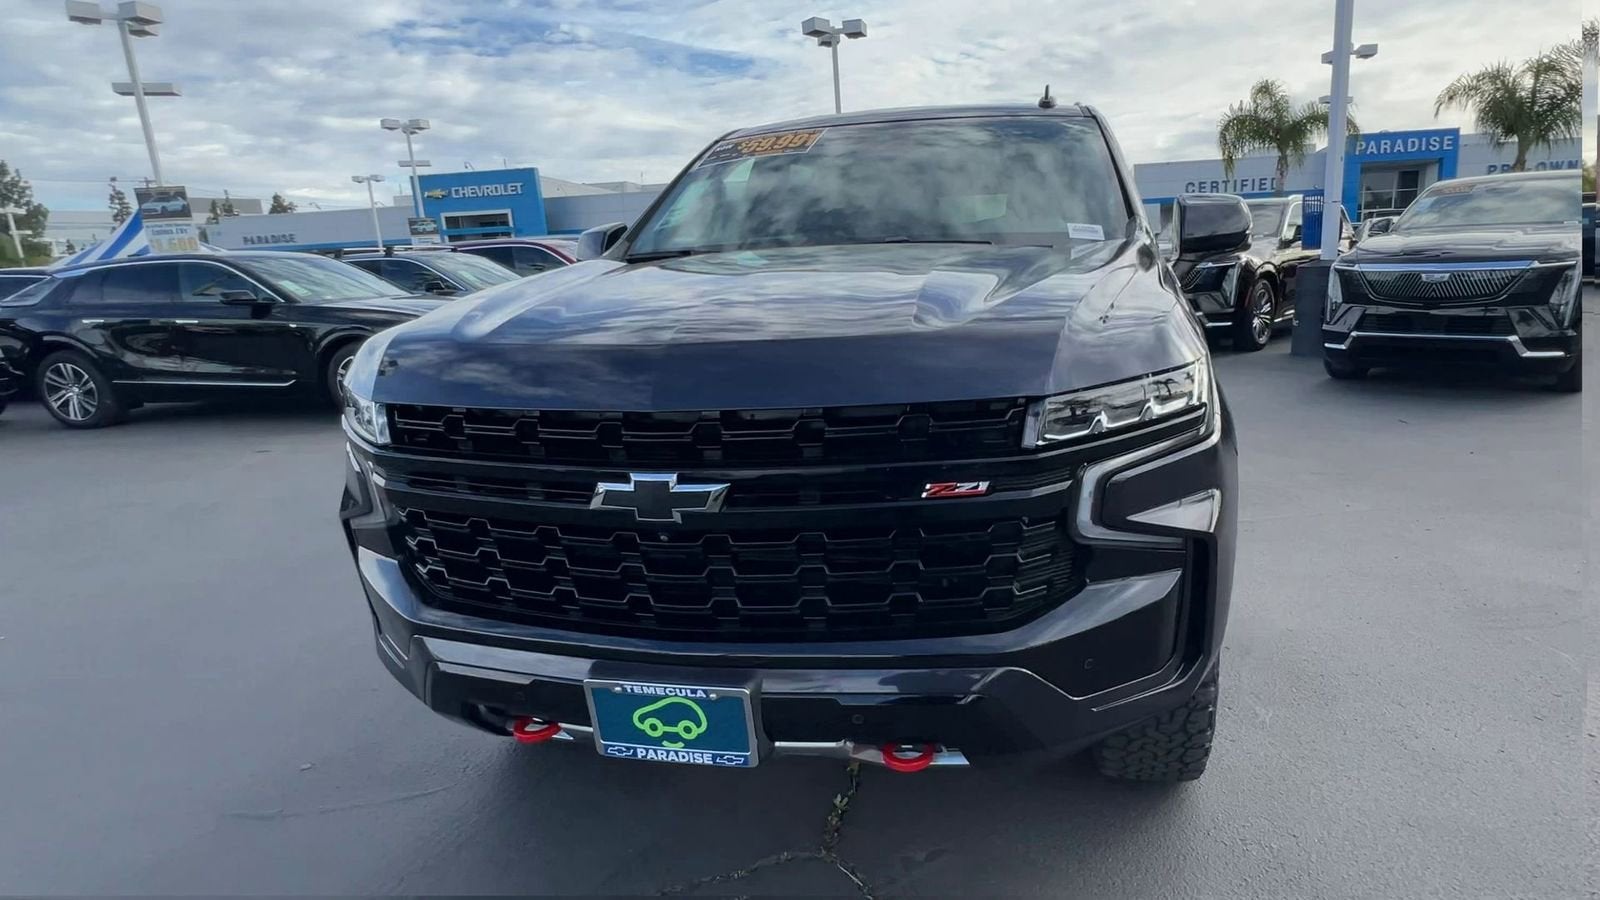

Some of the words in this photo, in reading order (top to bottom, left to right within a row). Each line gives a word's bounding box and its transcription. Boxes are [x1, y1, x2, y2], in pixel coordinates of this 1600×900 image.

[1355, 136, 1454, 155] PARADISE
[451, 183, 523, 198] CHEVROLET
[242, 234, 296, 244] PARADISE
[921, 481, 990, 498] Z71
[624, 685, 706, 698] TEMECULA
[636, 748, 714, 764] PARADISE
